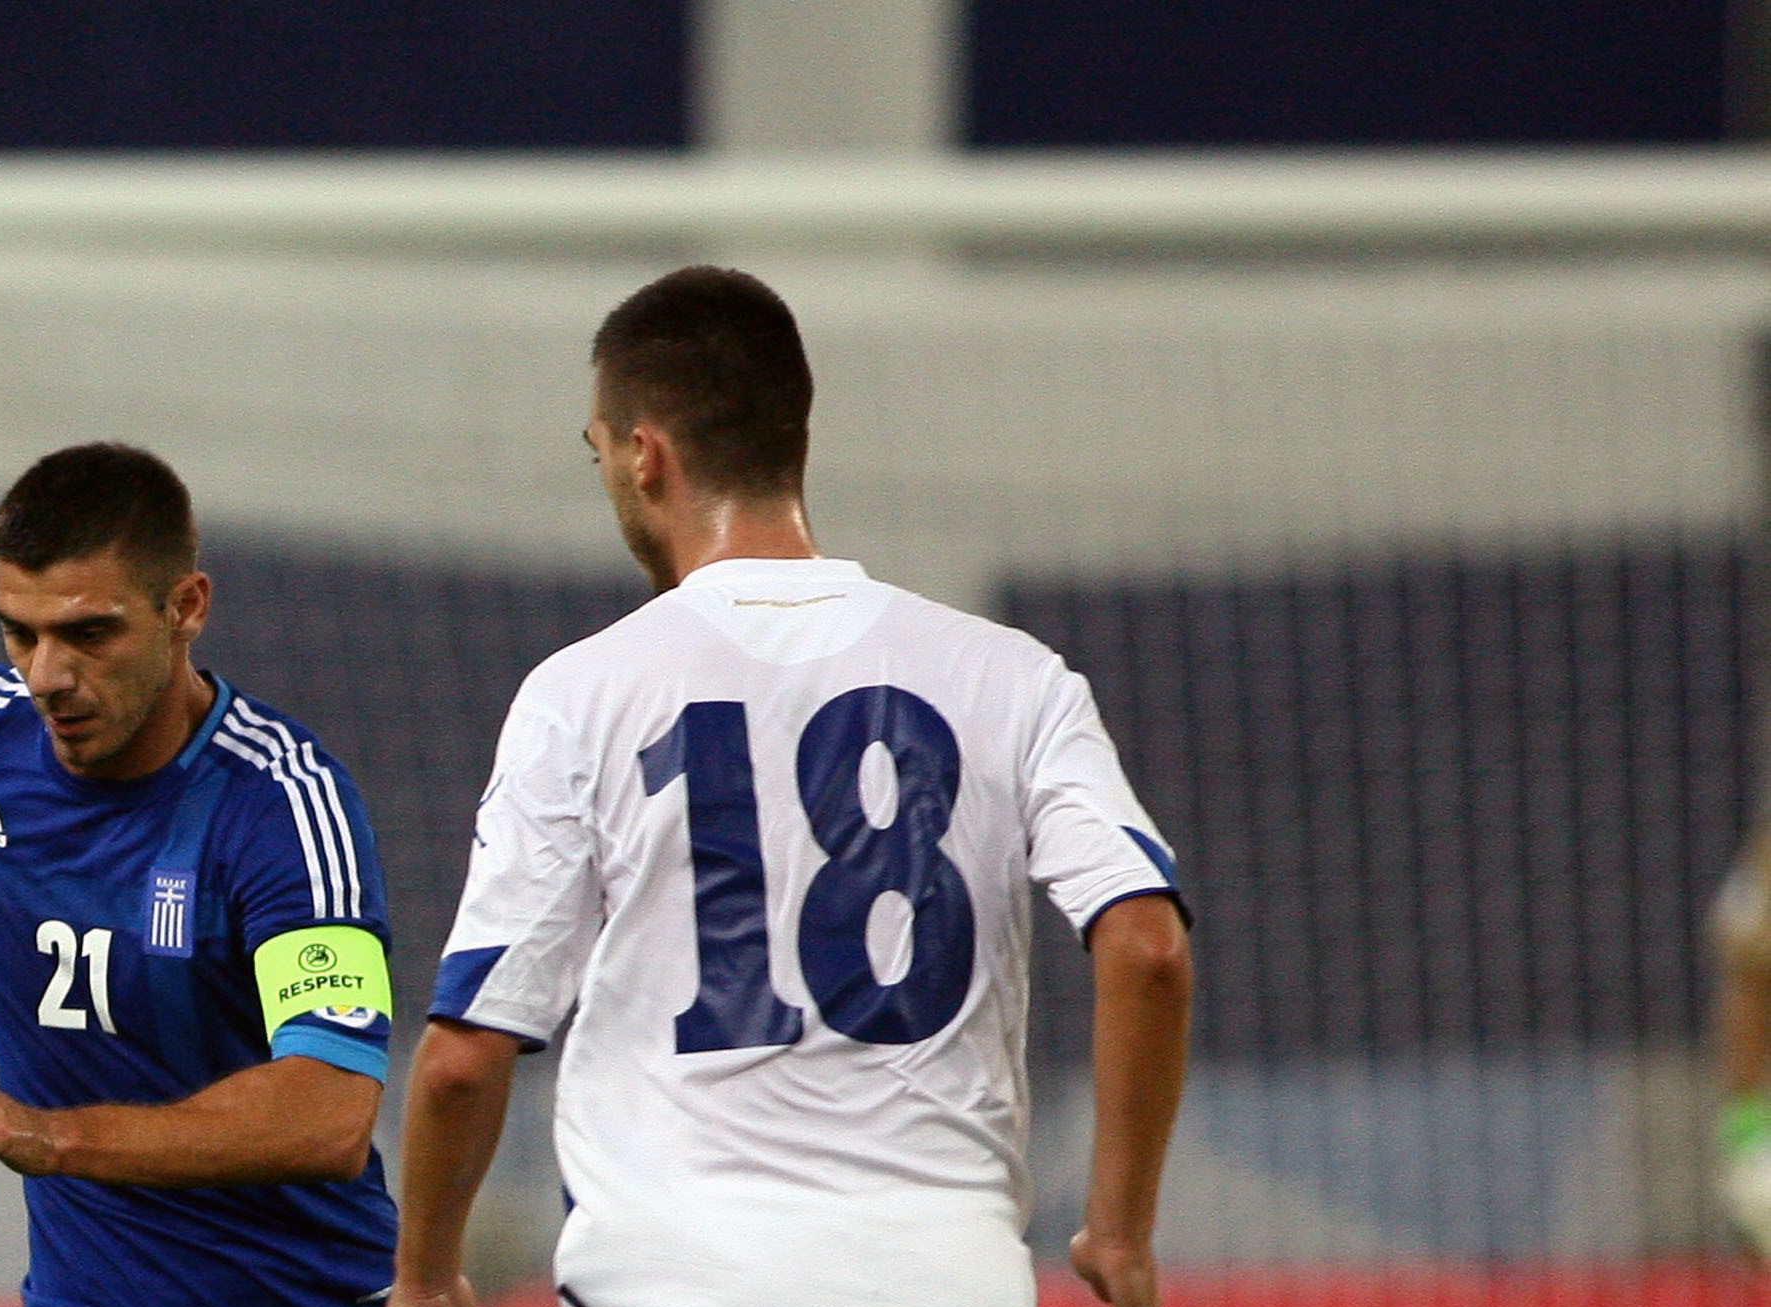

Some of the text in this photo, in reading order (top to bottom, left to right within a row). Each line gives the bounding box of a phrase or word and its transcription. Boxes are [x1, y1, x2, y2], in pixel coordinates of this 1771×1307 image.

[638, 686, 976, 1055] 18
[36, 920, 117, 1034] 21
[279, 974, 364, 1003] RESPECT
